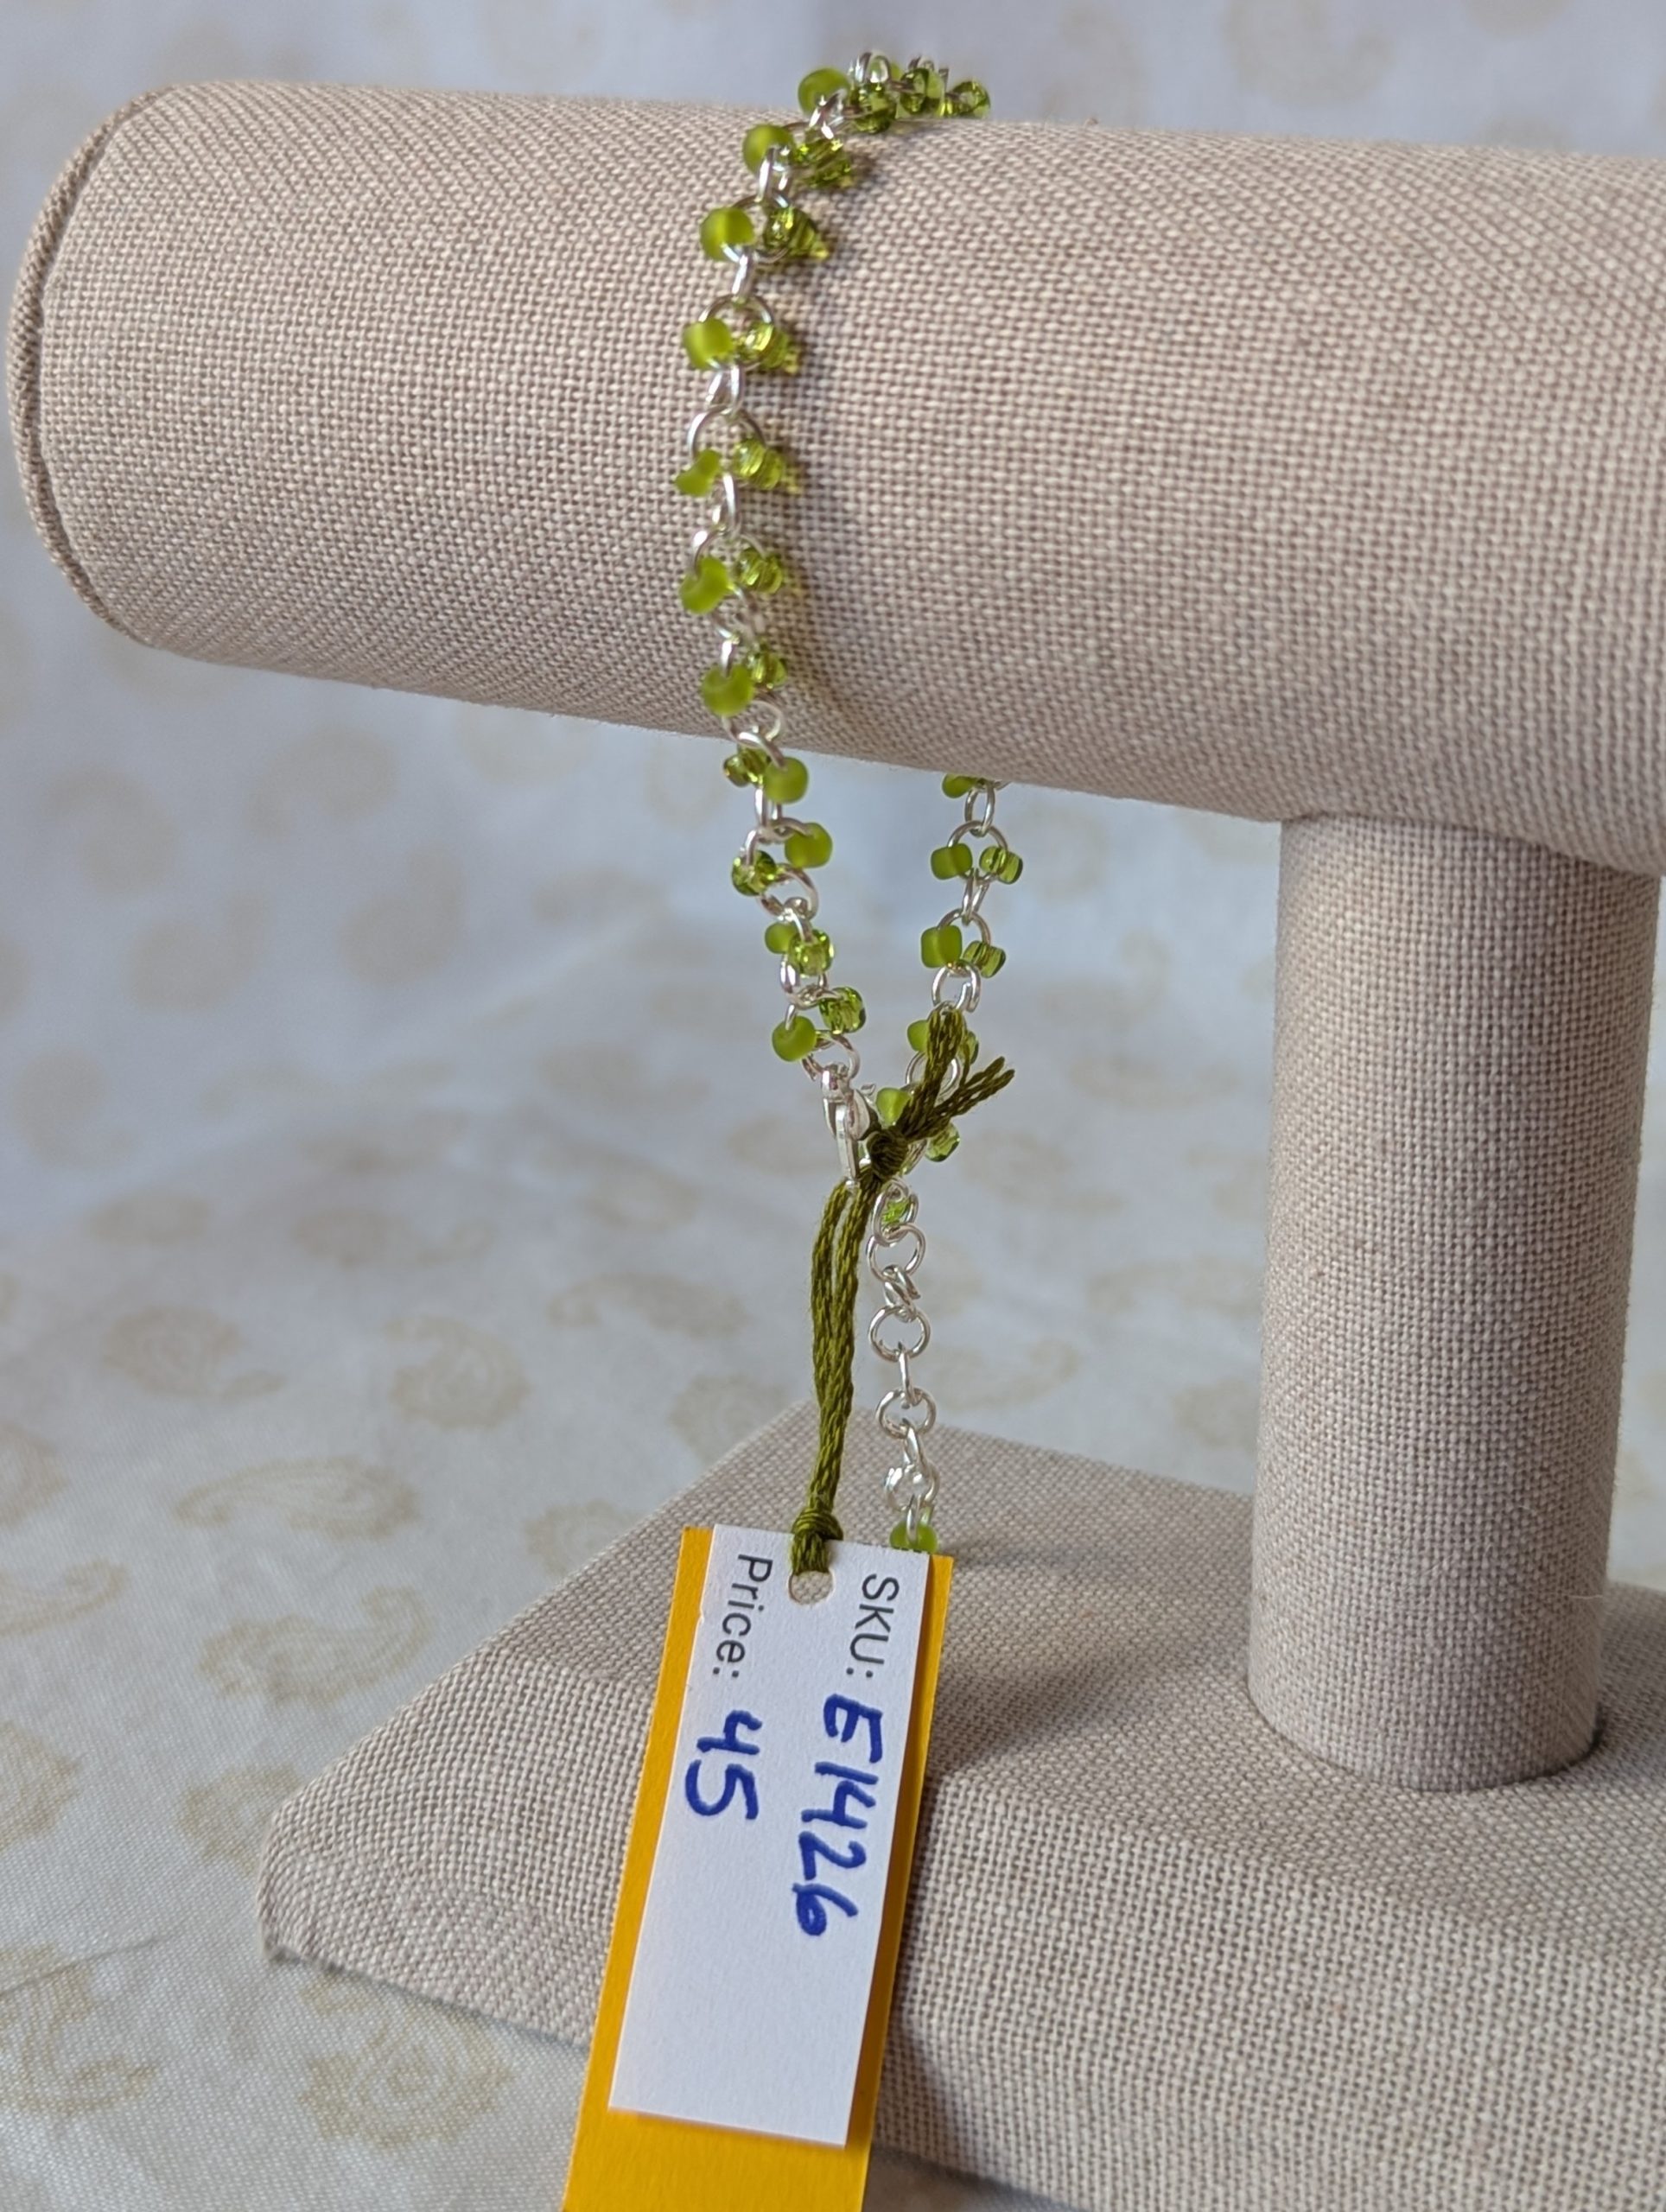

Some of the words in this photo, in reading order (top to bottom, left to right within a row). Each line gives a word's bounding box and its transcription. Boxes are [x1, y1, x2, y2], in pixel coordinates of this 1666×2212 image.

[711, 1554, 773, 1678] Price:
[846, 1573, 900, 1678] SKU:
[684, 1708, 763, 1821] 45
[791, 1693, 883, 1937] E1426
